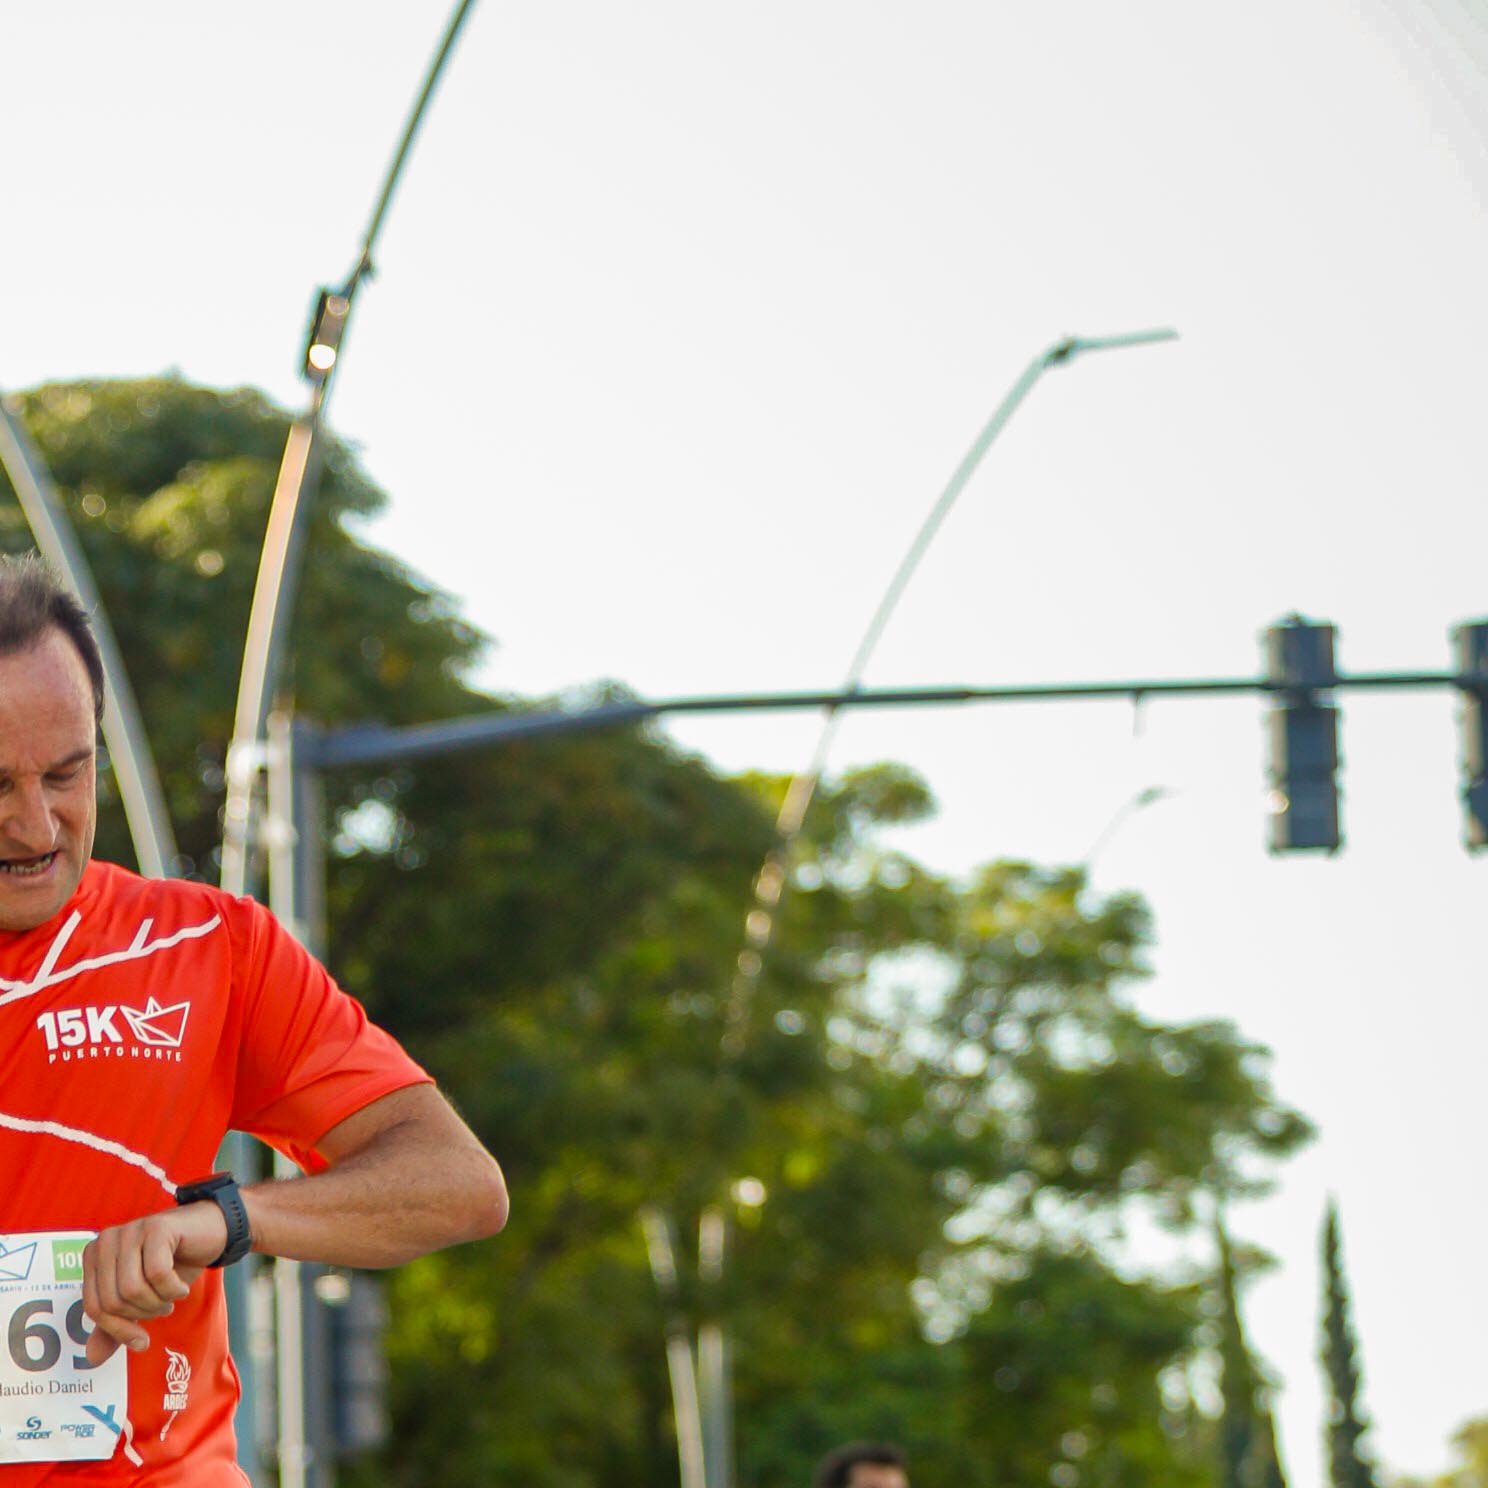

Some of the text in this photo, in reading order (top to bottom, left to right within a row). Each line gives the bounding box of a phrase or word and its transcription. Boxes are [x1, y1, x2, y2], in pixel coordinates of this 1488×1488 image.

[37, 1006, 123, 1050] 15K
[48, 1046, 182, 1064] PUERTO NORTE
[48, 1379, 94, 1394] Daniel
